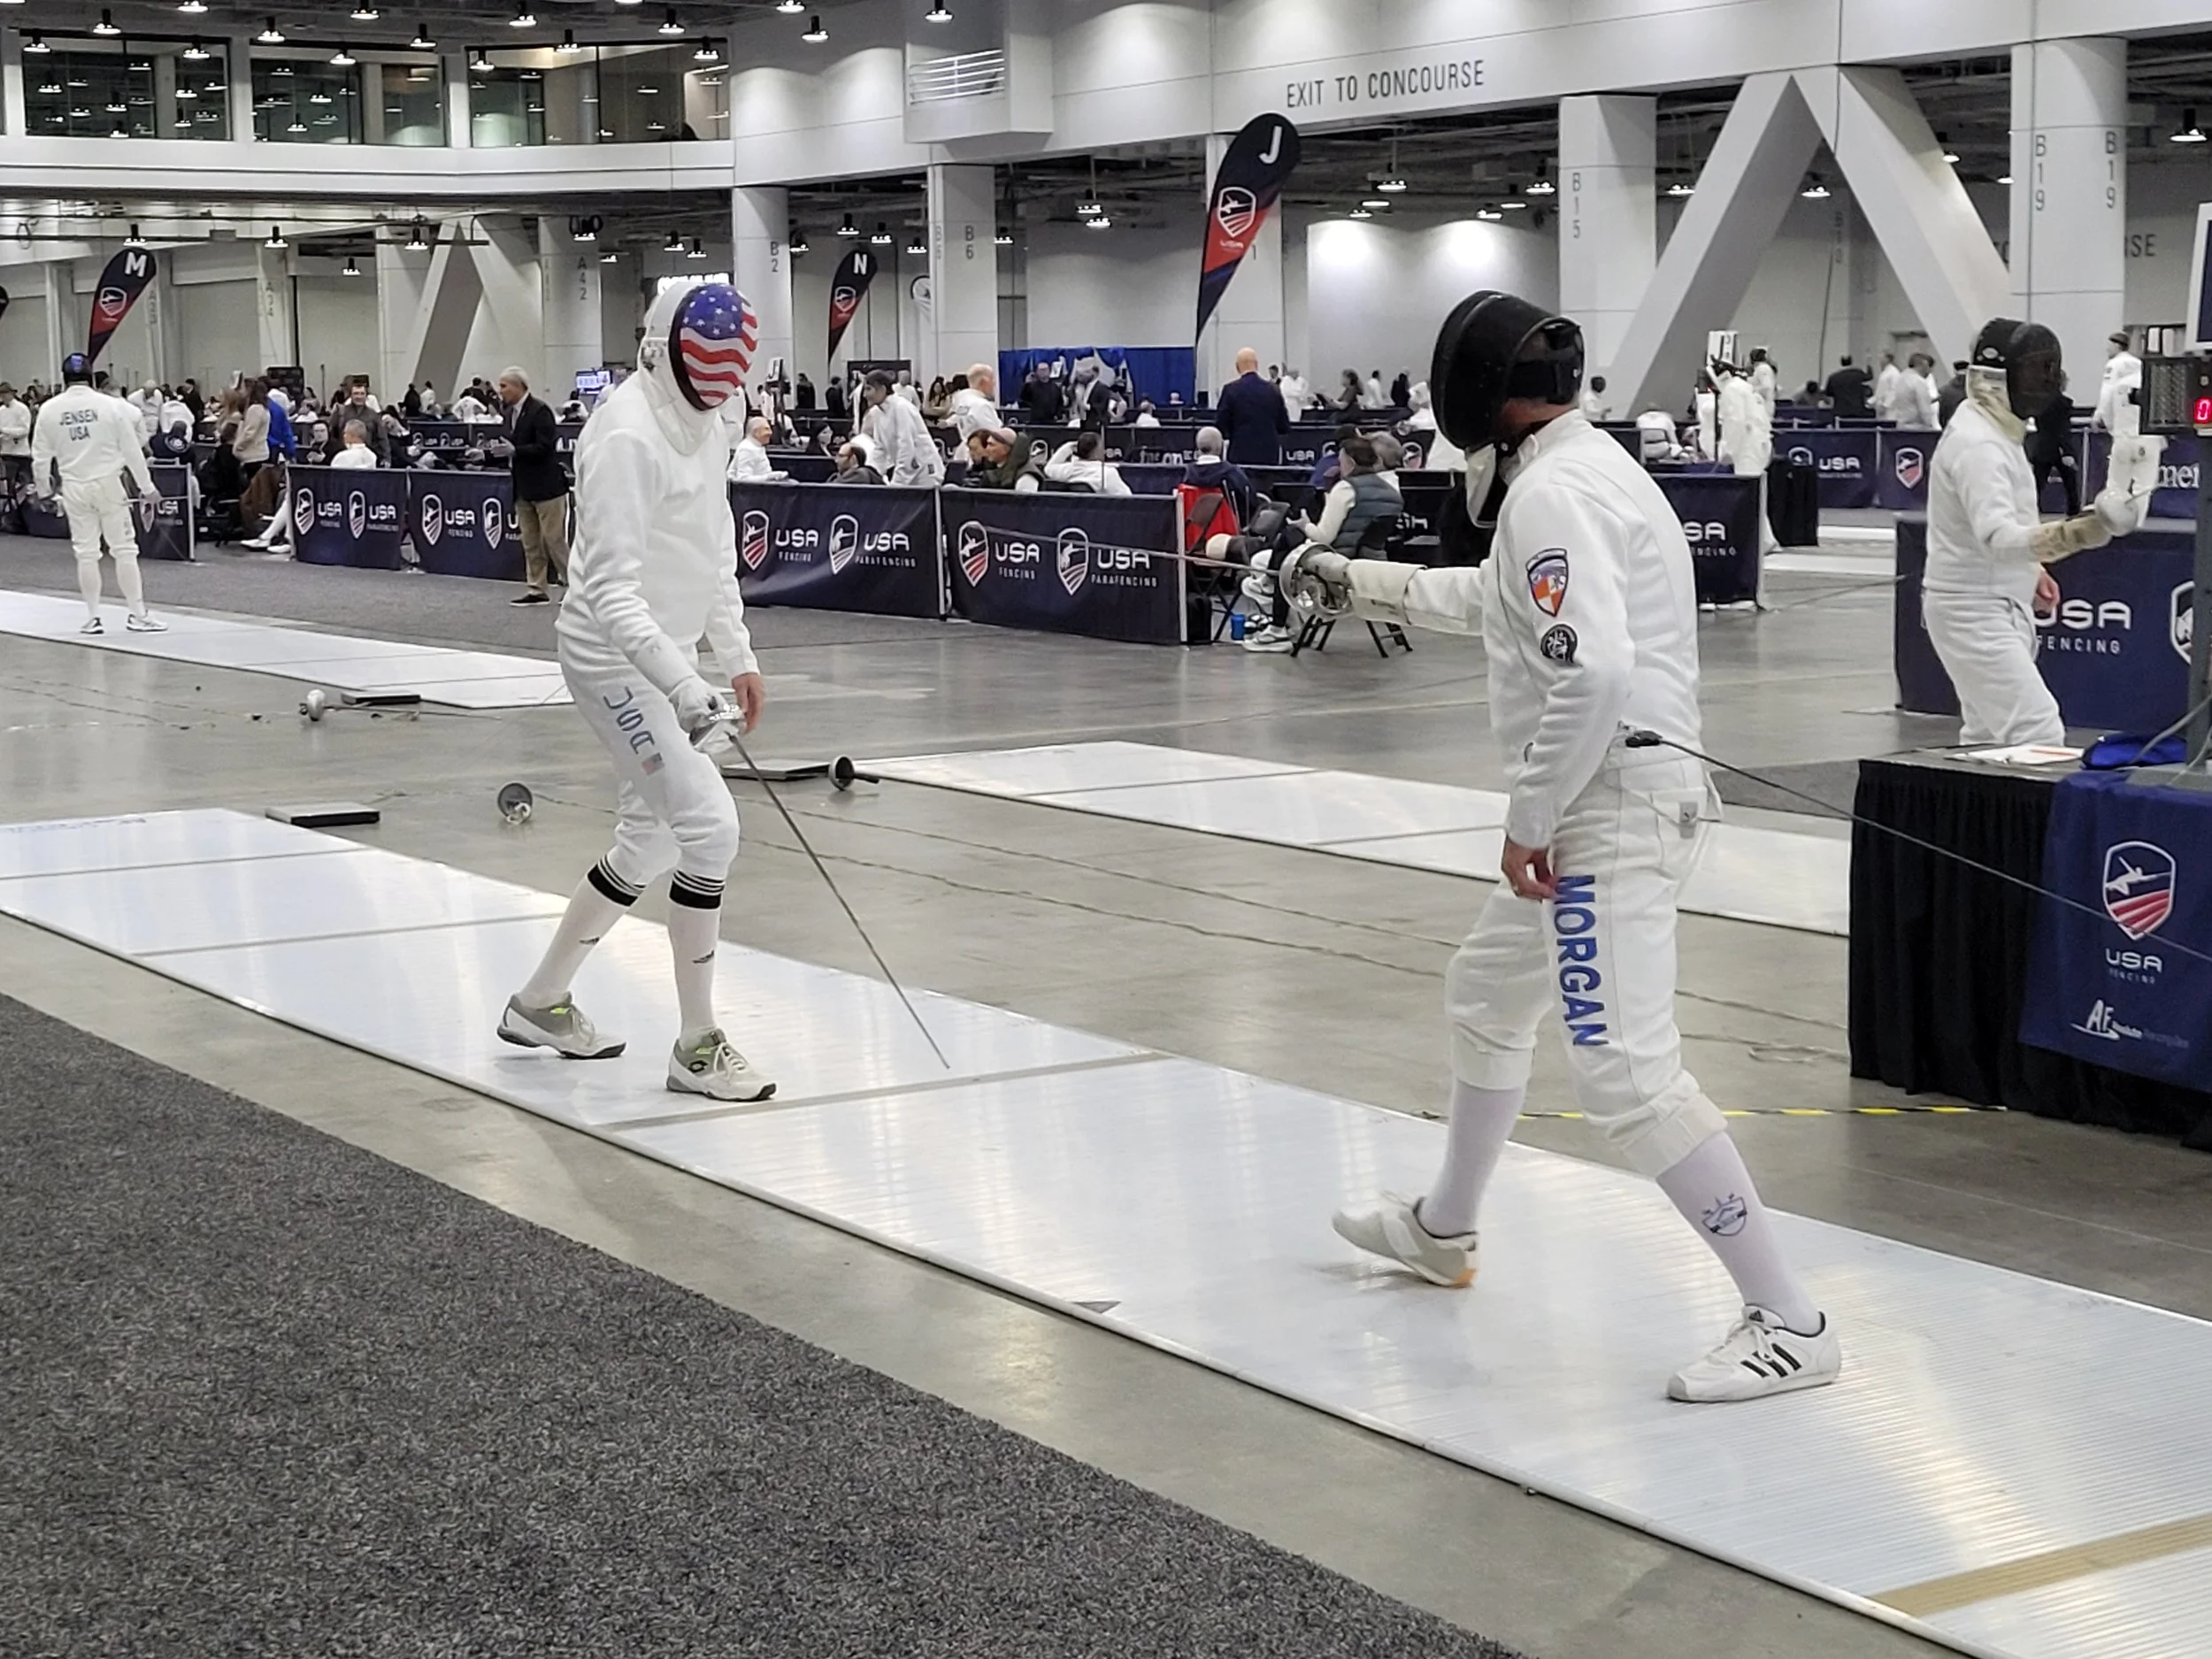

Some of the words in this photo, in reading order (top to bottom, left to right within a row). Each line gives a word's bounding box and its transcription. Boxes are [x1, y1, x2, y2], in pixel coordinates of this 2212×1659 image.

[1286, 79, 1325, 108] EXIT
[1335, 75, 1358, 103] TO
[1368, 59, 1485, 99] CONCOURSE
[1258, 125, 1283, 165] J
[124, 251, 148, 278] M
[854, 253, 868, 275] N
[59, 409, 99, 426] JENSEN
[69, 426, 92, 442] USA
[1818, 457, 1861, 471] USA
[318, 502, 342, 518] USA
[369, 504, 397, 521] USA
[444, 509, 476, 526] USA
[774, 528, 819, 548] USA
[863, 532, 910, 552] USA
[1683, 520, 1726, 542] SA
[994, 541, 1041, 564] USA
[1096, 548, 1150, 571] USA
[2037, 635, 2122, 655] FENCING
[603, 686, 656, 756] USA
[1553, 873, 1609, 1048] MORGAN
[2105, 948, 2162, 972] USA
